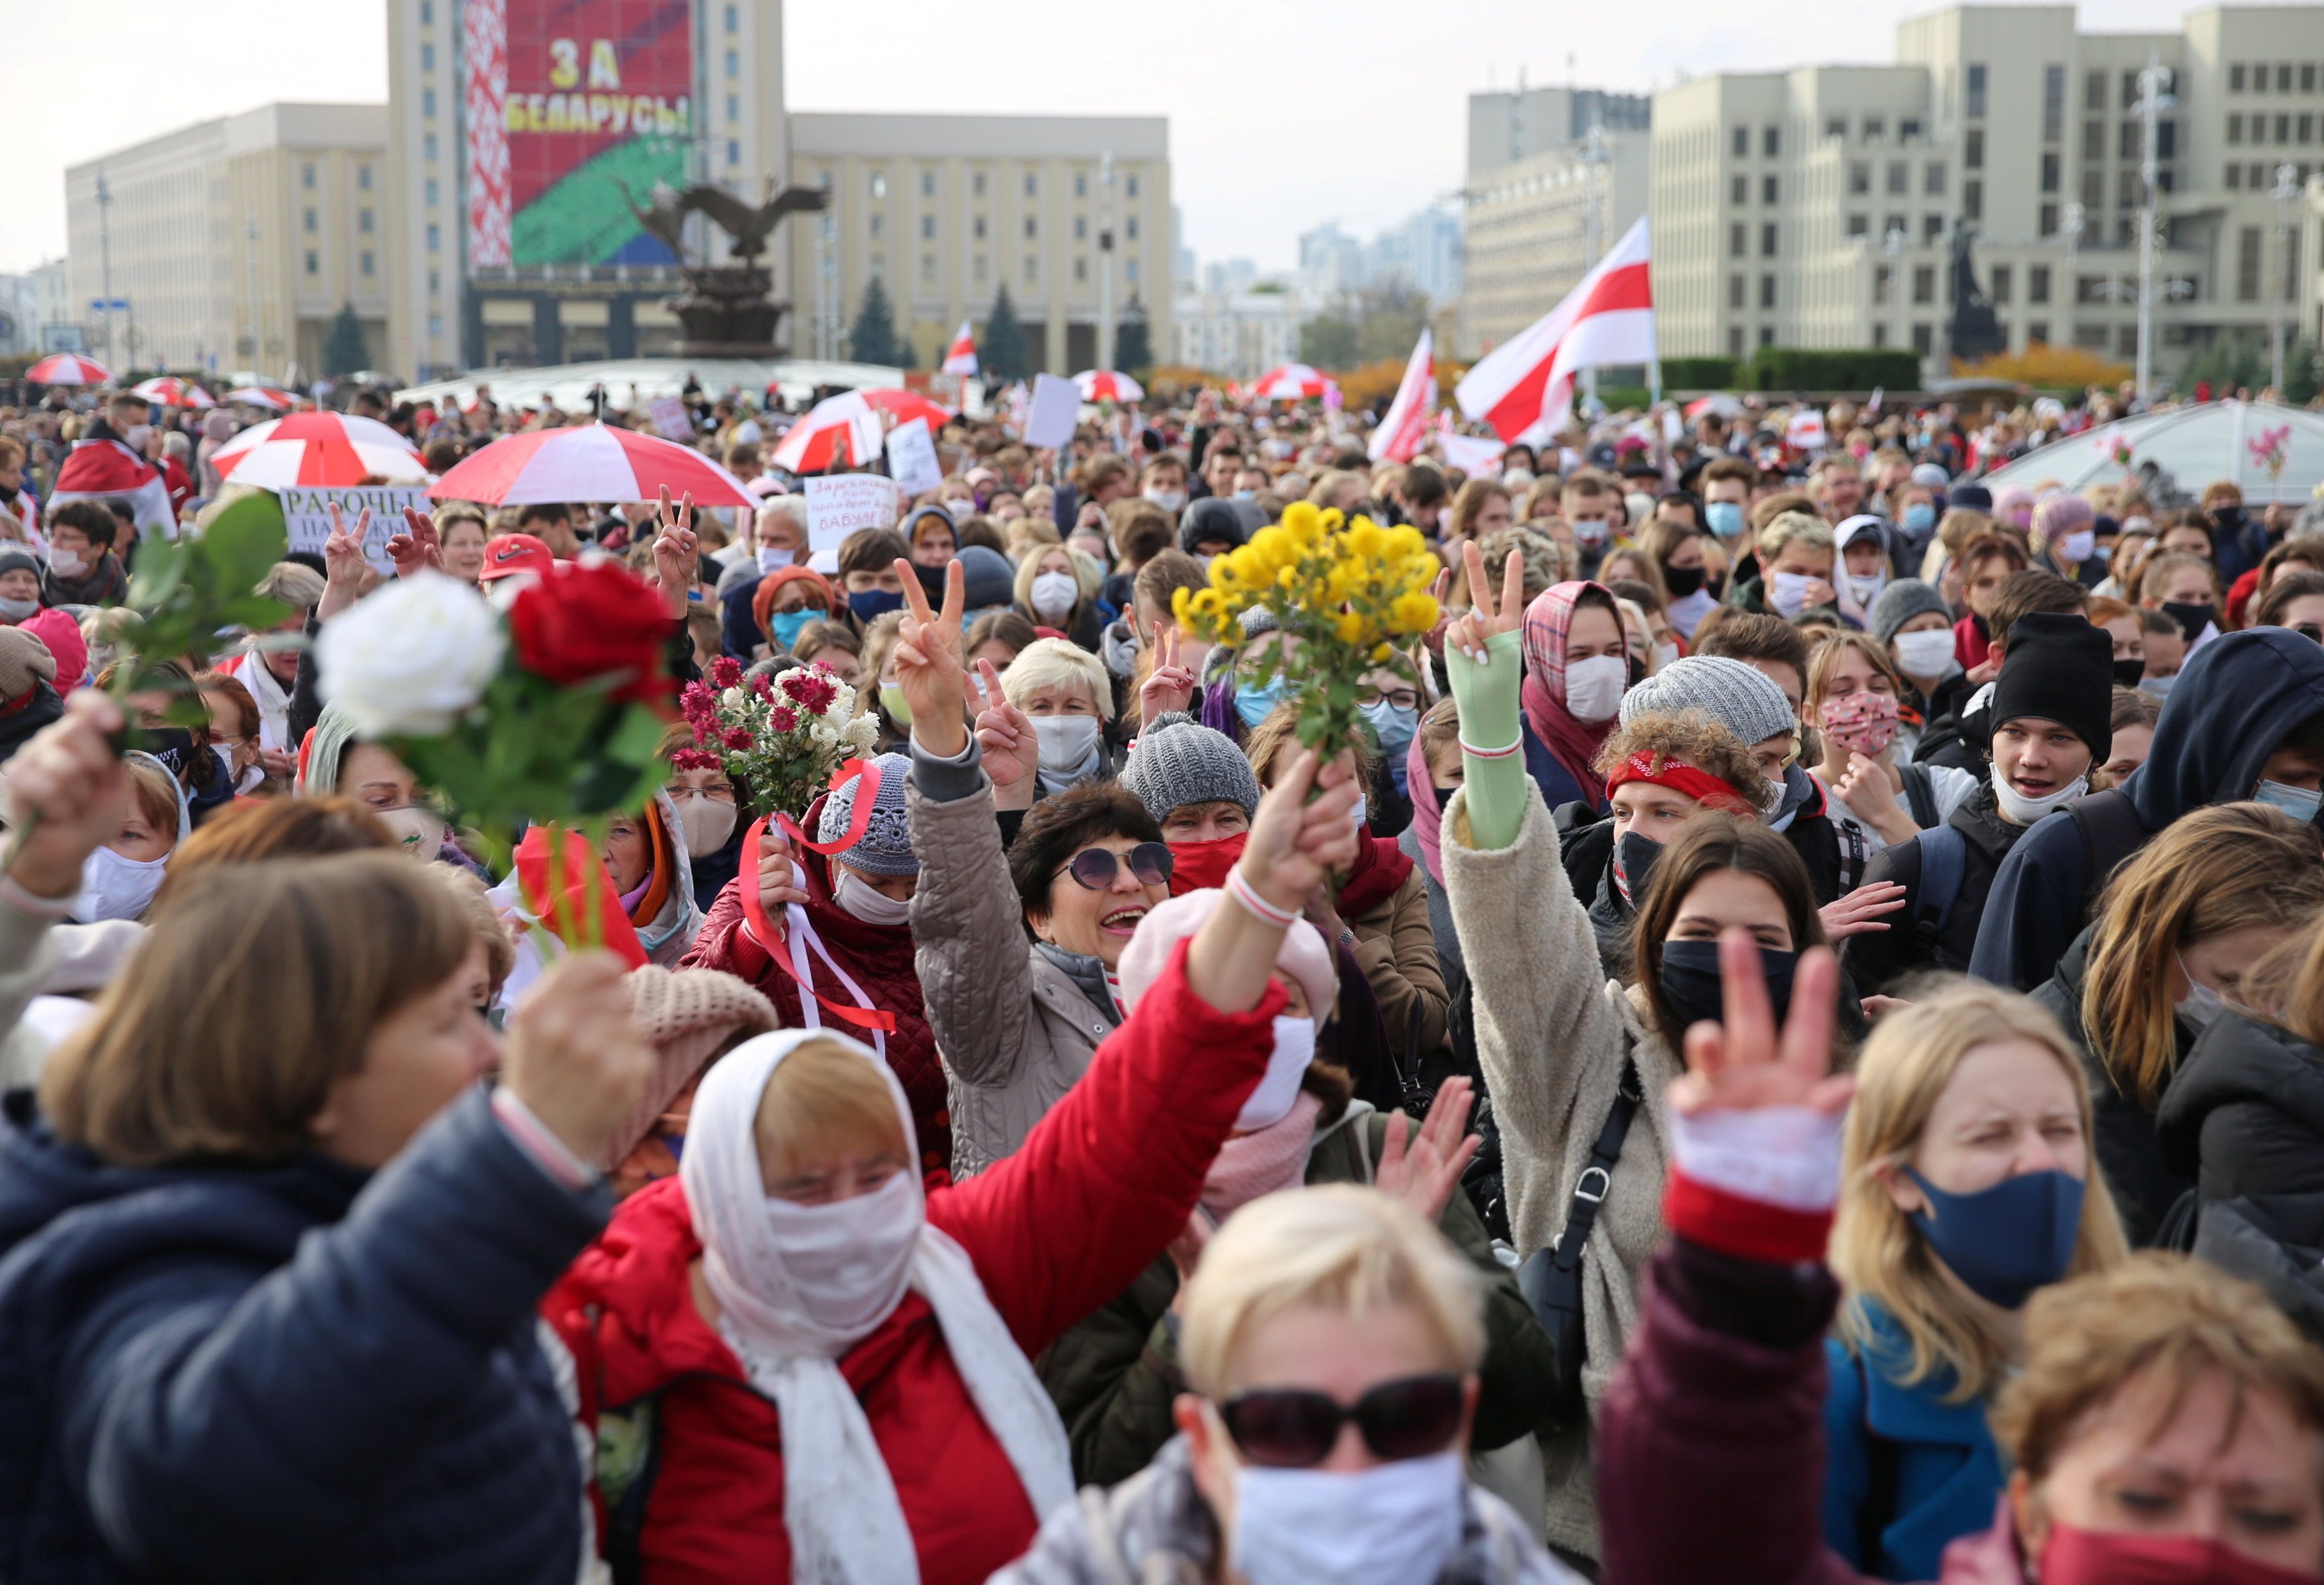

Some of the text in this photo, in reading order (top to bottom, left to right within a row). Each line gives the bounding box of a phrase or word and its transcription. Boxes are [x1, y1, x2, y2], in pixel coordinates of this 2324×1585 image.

[549, 37, 621, 89] ЗА
[505, 91, 688, 135] БЕЛАРУСЬ!
[286, 490, 413, 515] РАБОЧЫ
[301, 519, 406, 536] ПАЖЫ
